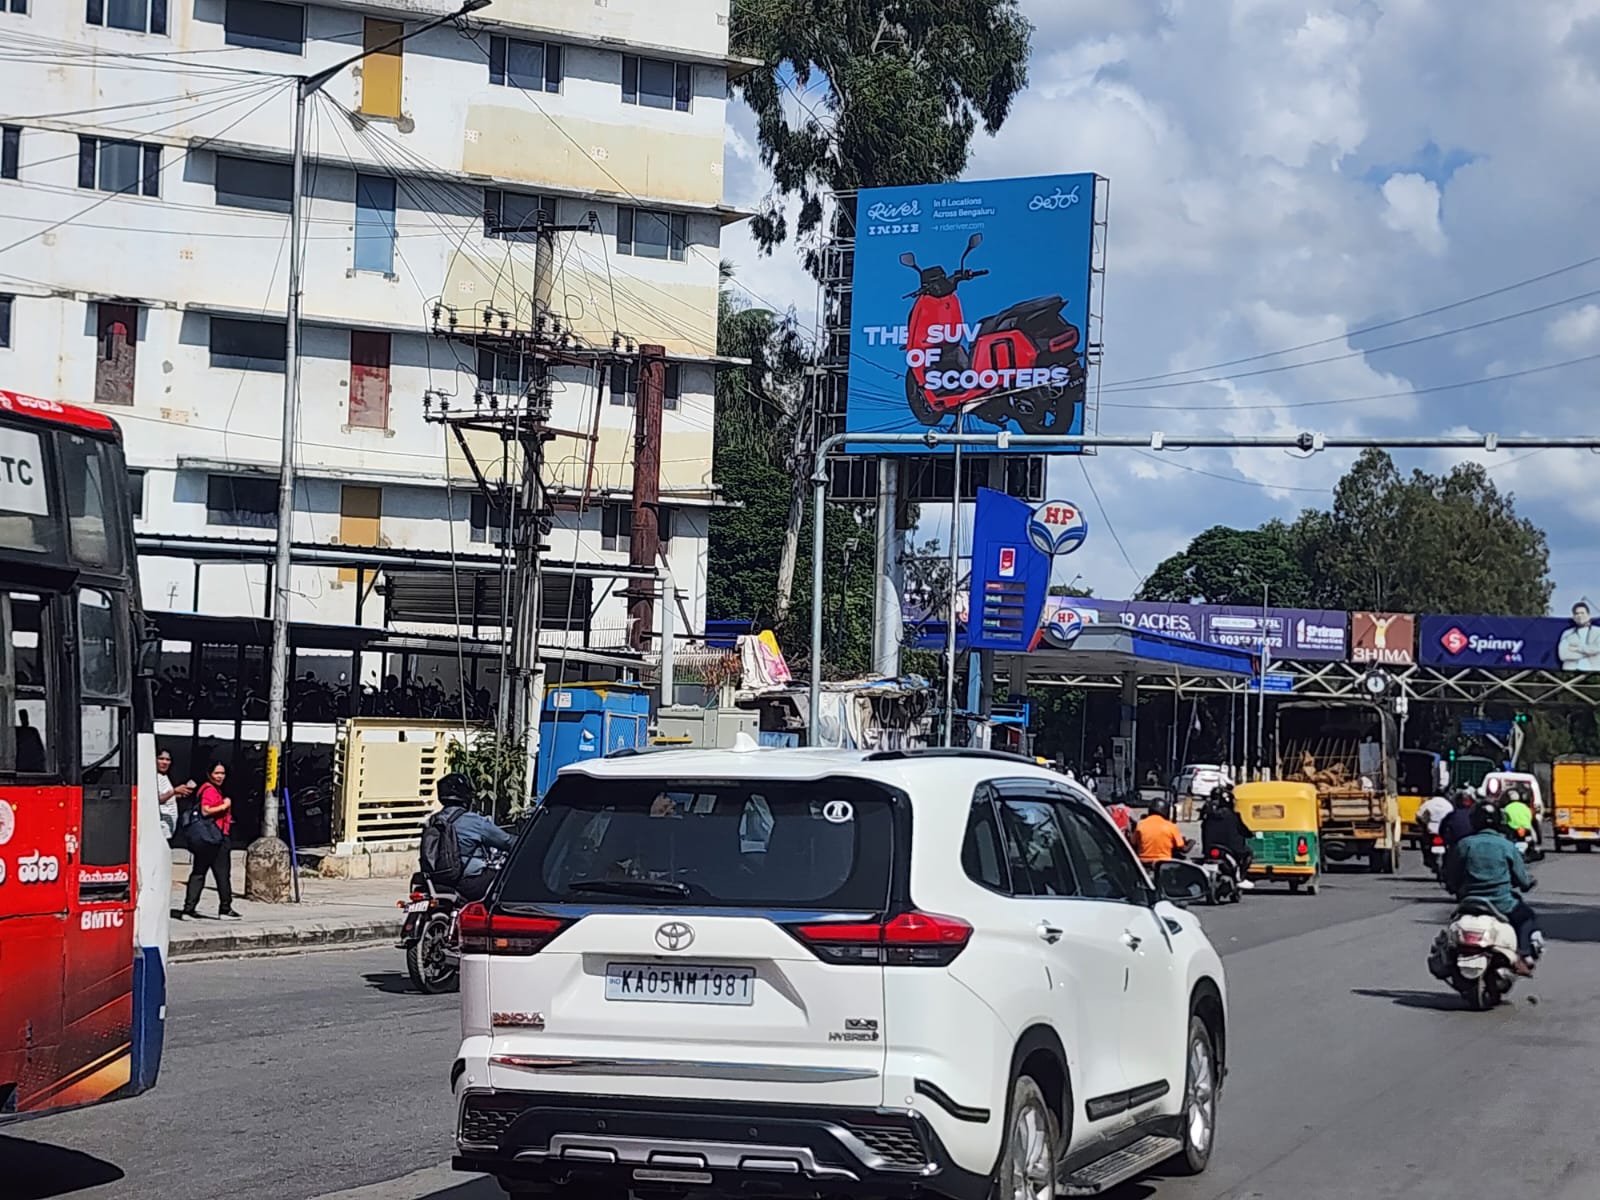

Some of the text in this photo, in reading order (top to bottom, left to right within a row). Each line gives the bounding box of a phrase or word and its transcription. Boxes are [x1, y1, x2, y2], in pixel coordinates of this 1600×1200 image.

[867, 200, 922, 223] River
[933, 199, 941, 208] In
[947, 197, 983, 207] Locations
[933, 208, 996, 218] Across Bengaluru
[868, 224, 920, 236] INDIE
[863, 323, 982, 346] THE SUV
[905, 348, 942, 368] OF
[924, 367, 1070, 390] SCOOTERS
[1044, 505, 1075, 526] HP
[1057, 613, 1075, 624] HP
[1119, 612, 1136, 627] 19
[1468, 634, 1524, 653] Spinny
[80, 908, 124, 931] BMTC
[621, 969, 749, 998] KA05NM1981
